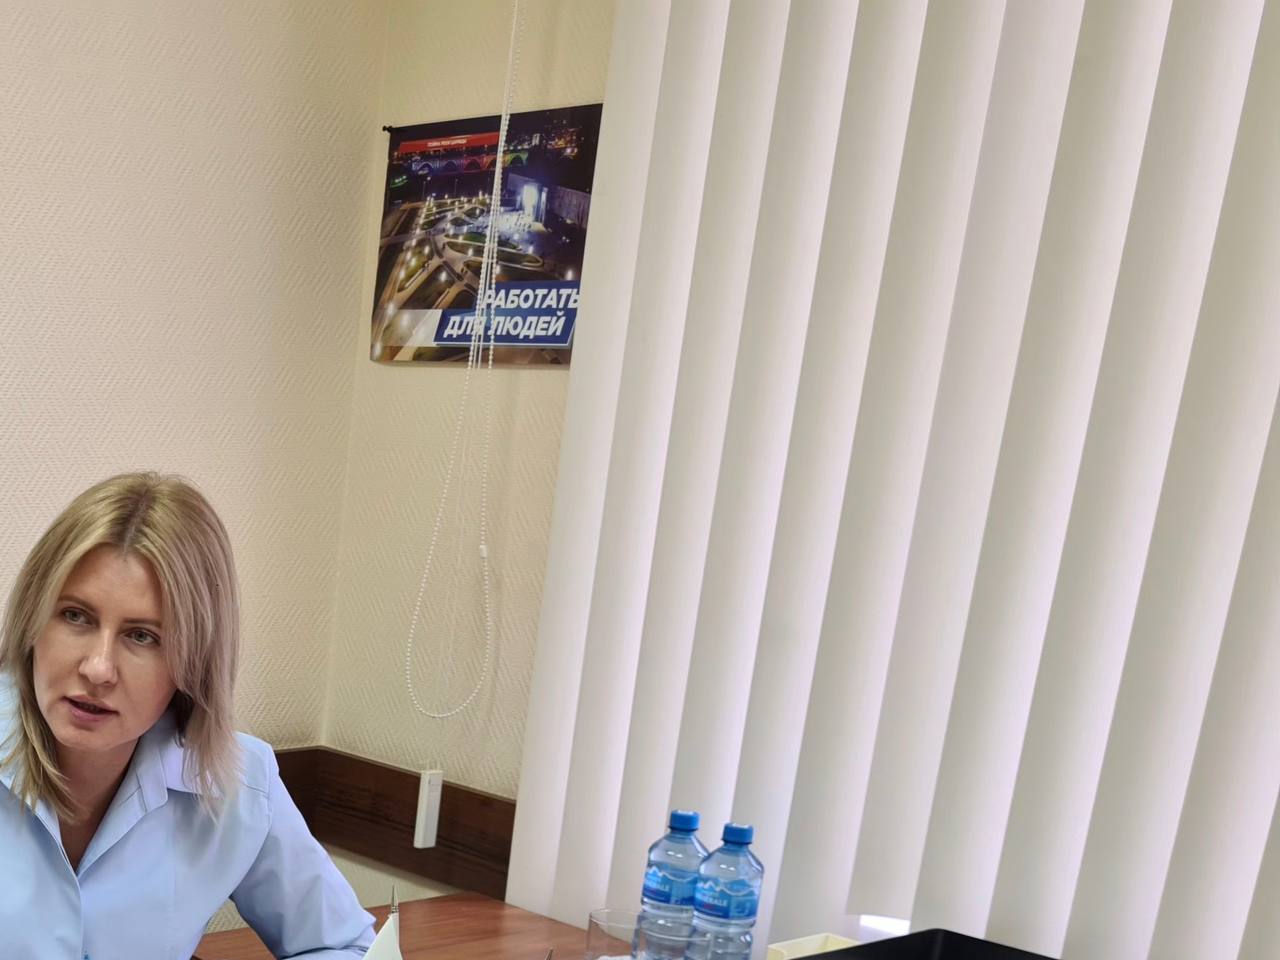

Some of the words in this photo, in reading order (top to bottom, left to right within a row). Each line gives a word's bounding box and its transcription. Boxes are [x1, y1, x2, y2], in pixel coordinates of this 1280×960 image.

[481, 288, 579, 309] РАБОТАТЬ
[443, 315, 486, 338] ДЛЯ
[488, 310, 567, 339] ЛЮДЕЙ
